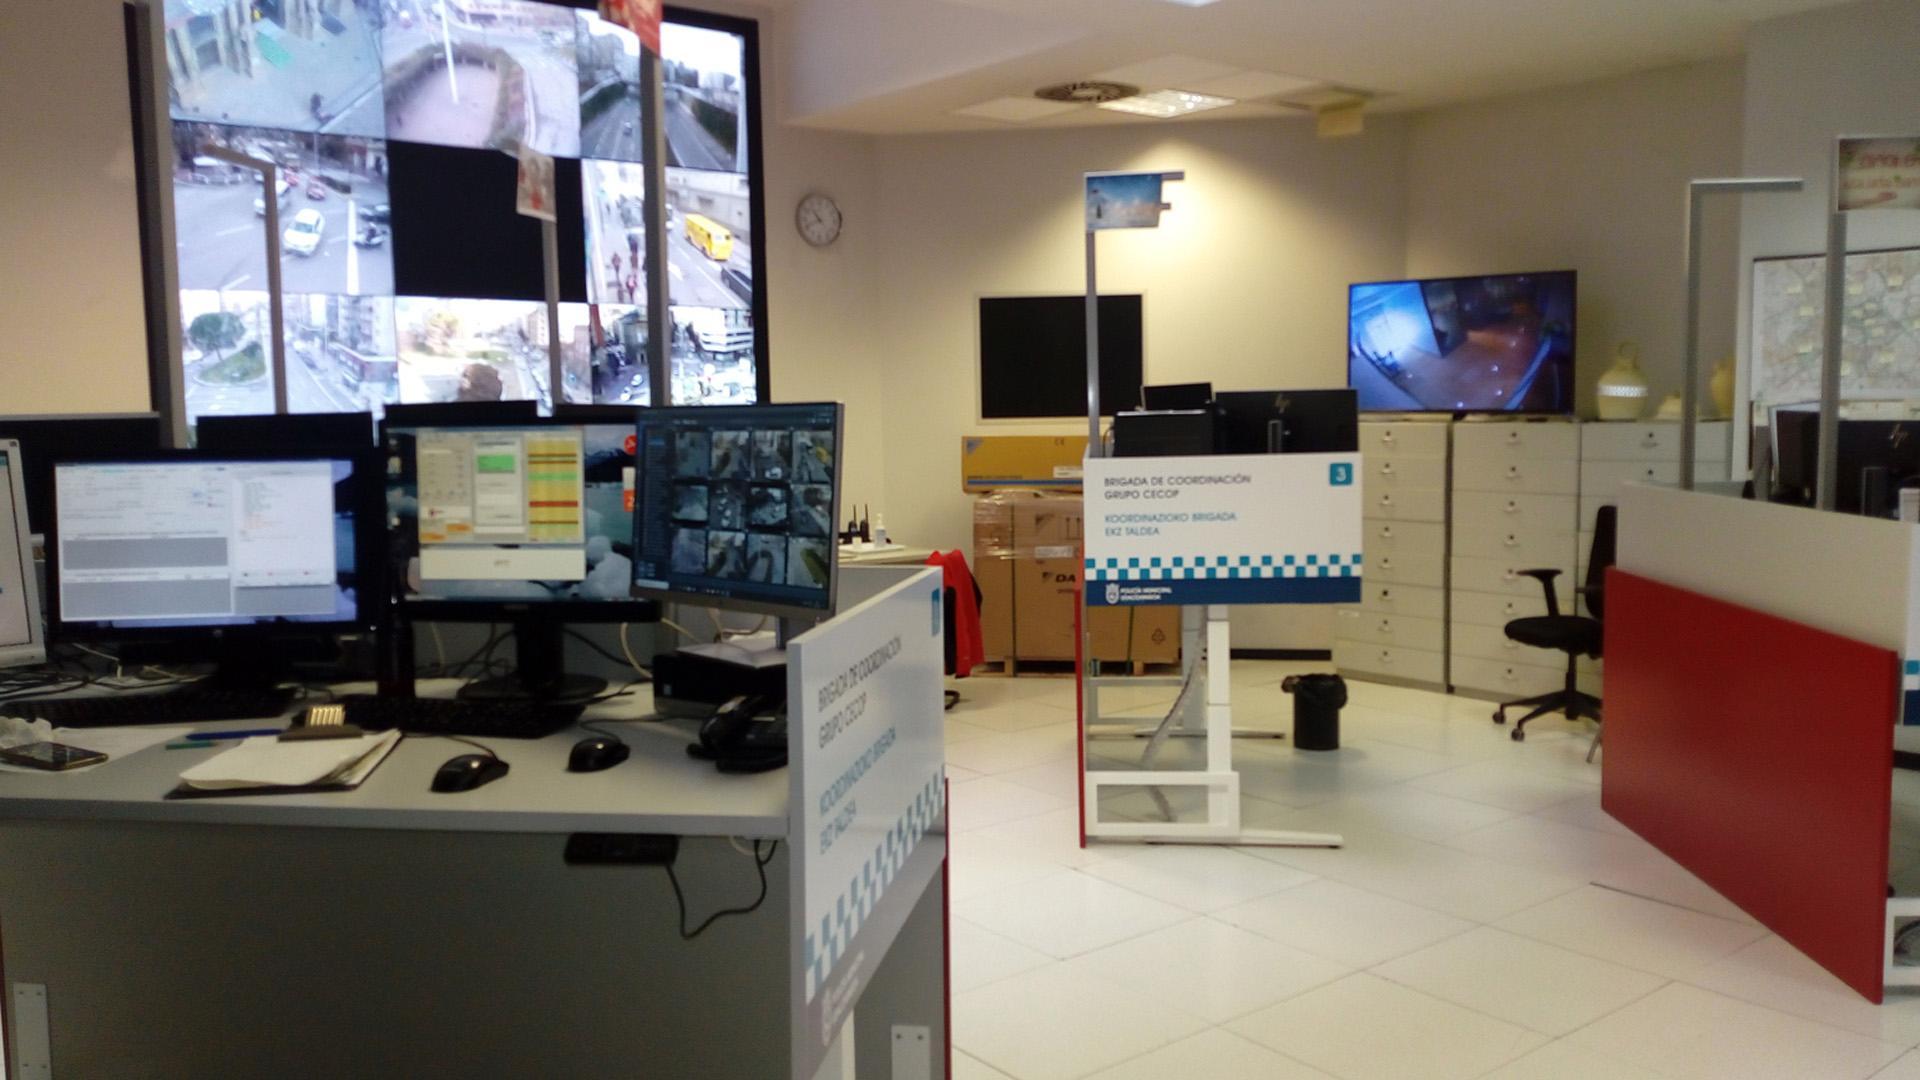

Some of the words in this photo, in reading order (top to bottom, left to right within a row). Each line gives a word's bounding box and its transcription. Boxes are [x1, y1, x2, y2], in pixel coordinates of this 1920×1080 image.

[1104, 476, 1149, 487] BRIGADA
[1150, 476, 1164, 486] DE
[1167, 473, 1252, 486] COORDINACIÓN
[1335, 466, 1347, 482] 3
[1104, 489, 1141, 500] GRUPO
[1143, 489, 1180, 499] CECOP
[1104, 512, 1189, 523] KOORDINAZIOKO
[1192, 511, 1237, 522] BRIGADA
[1105, 526, 1122, 537] EKZ
[1125, 526, 1160, 536] TALDEA
[819, 710, 843, 749] GRUPO
